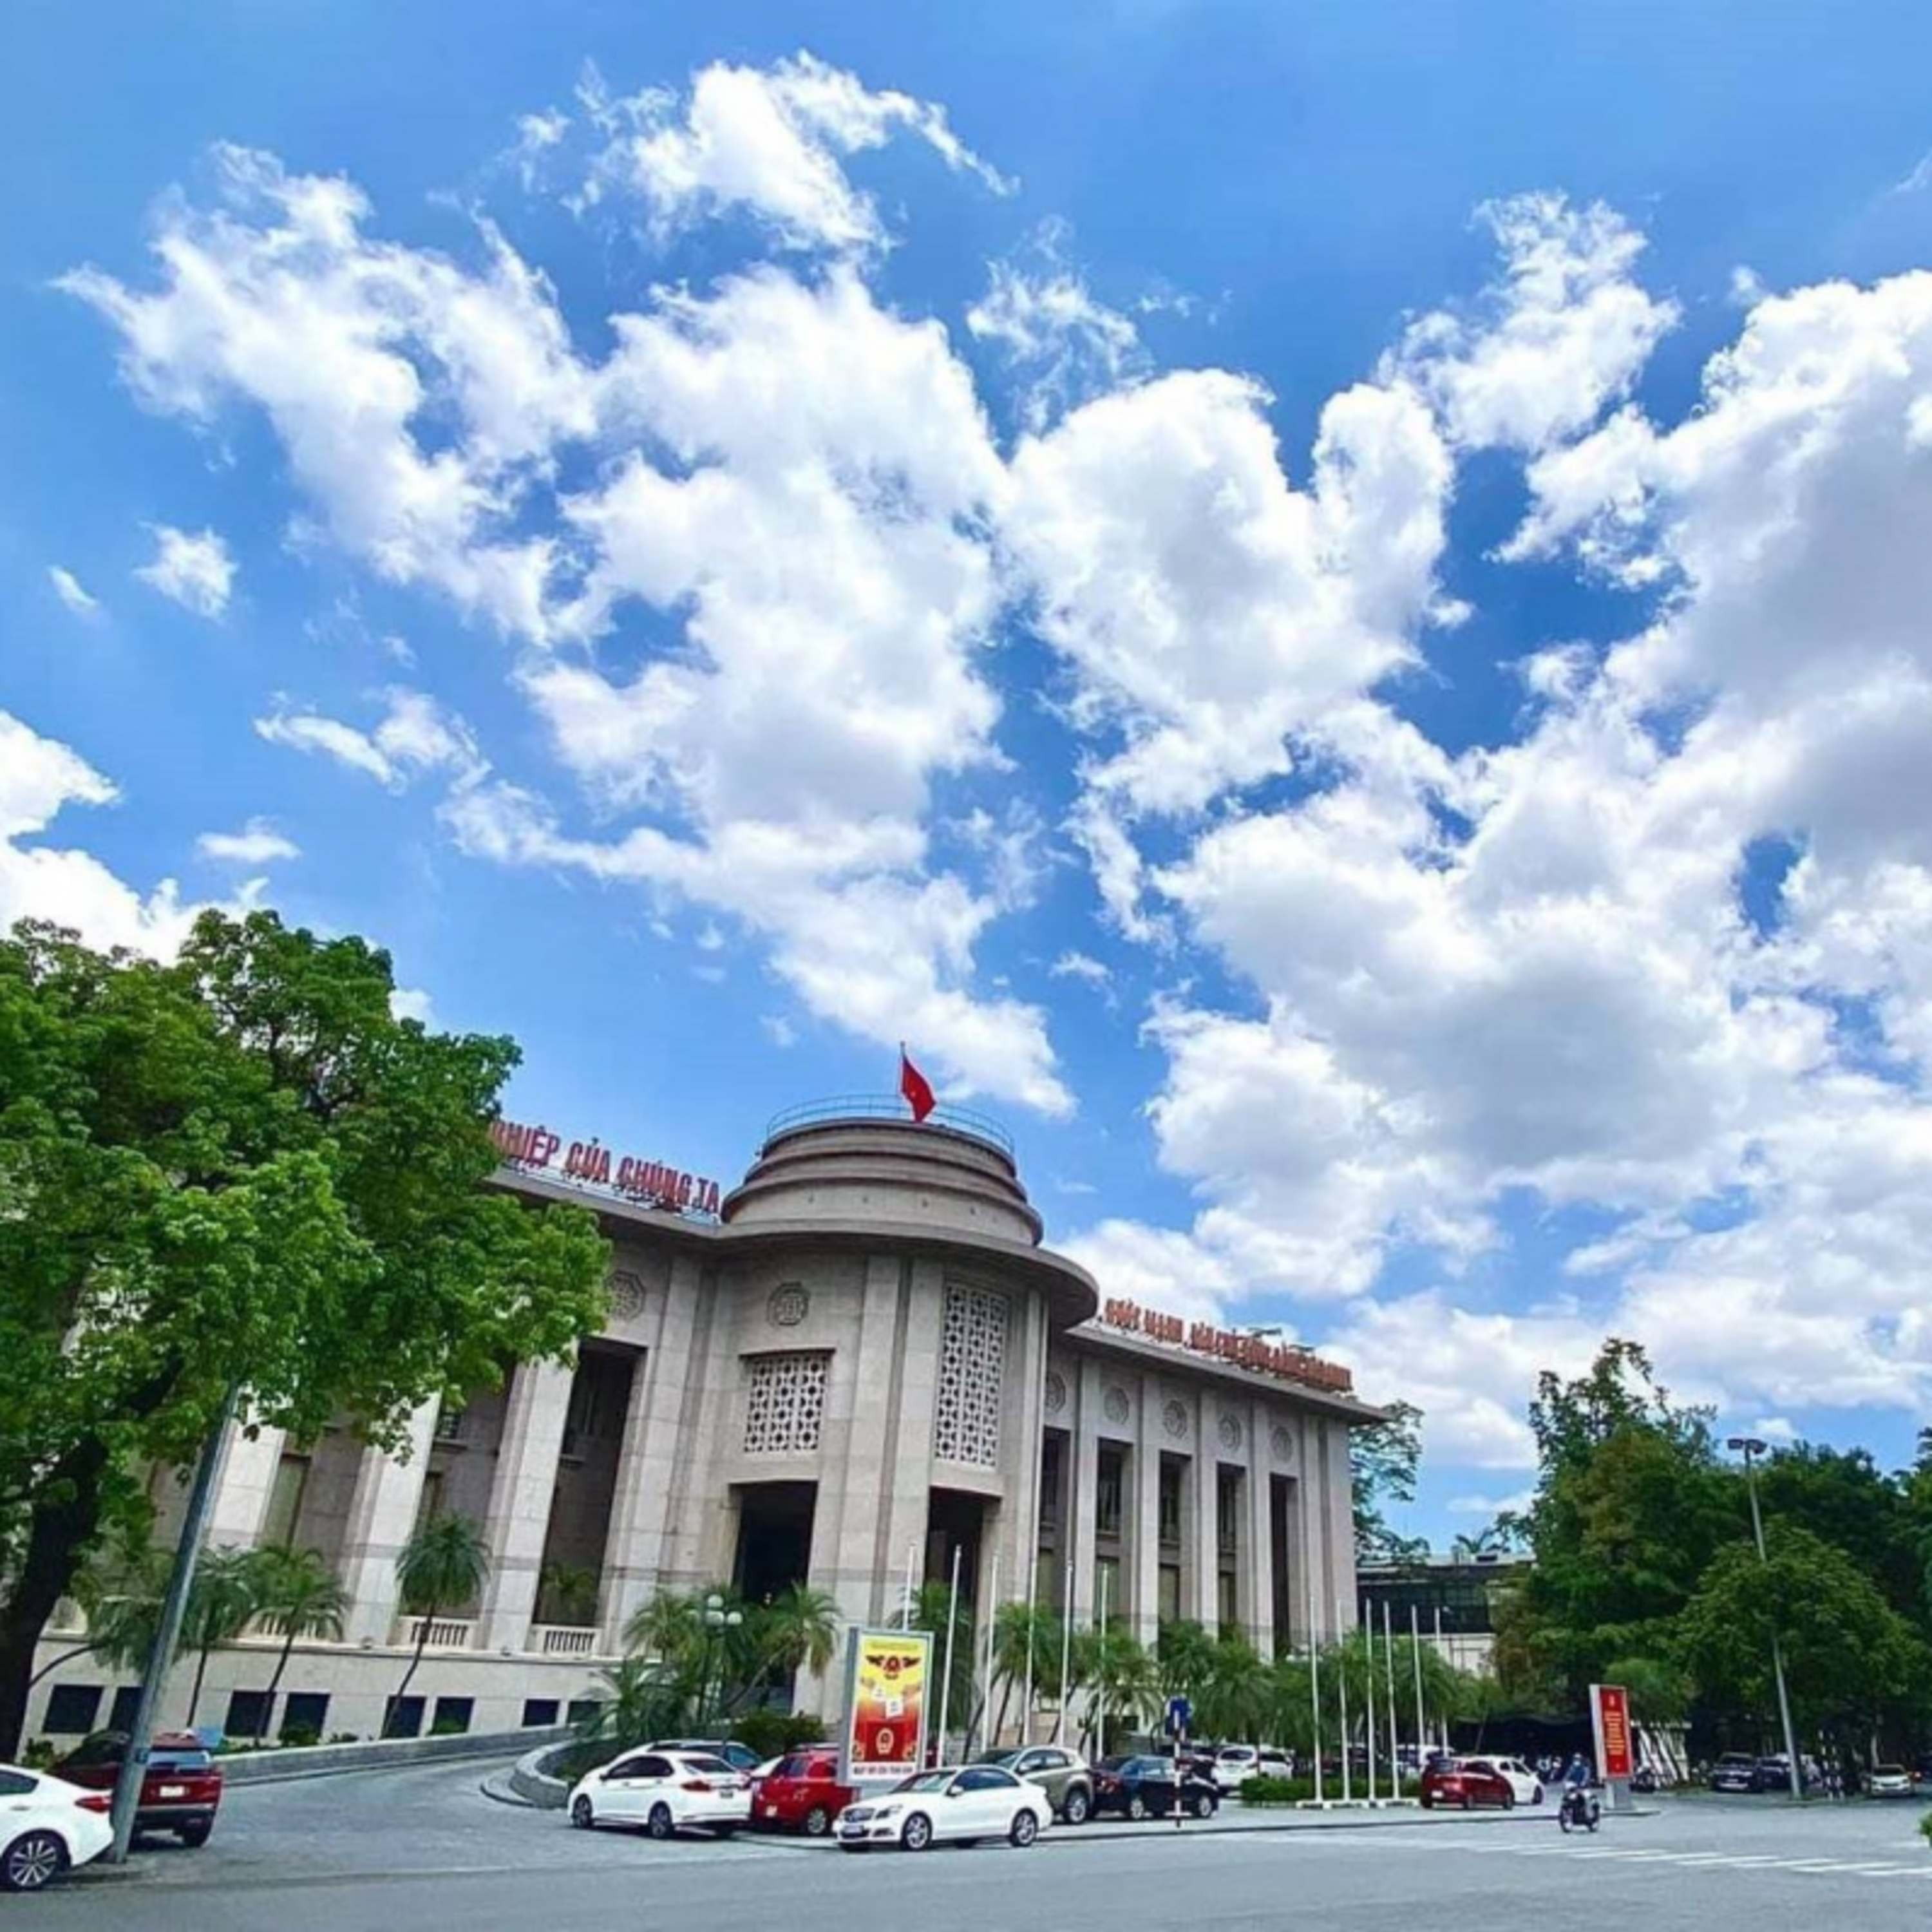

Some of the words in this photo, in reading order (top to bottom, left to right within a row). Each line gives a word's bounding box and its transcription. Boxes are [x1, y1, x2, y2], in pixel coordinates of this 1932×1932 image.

[564, 1136, 611, 1182] CỦA
[617, 1157, 692, 1212] CHÚNG
[696, 1177, 719, 1213] TA
